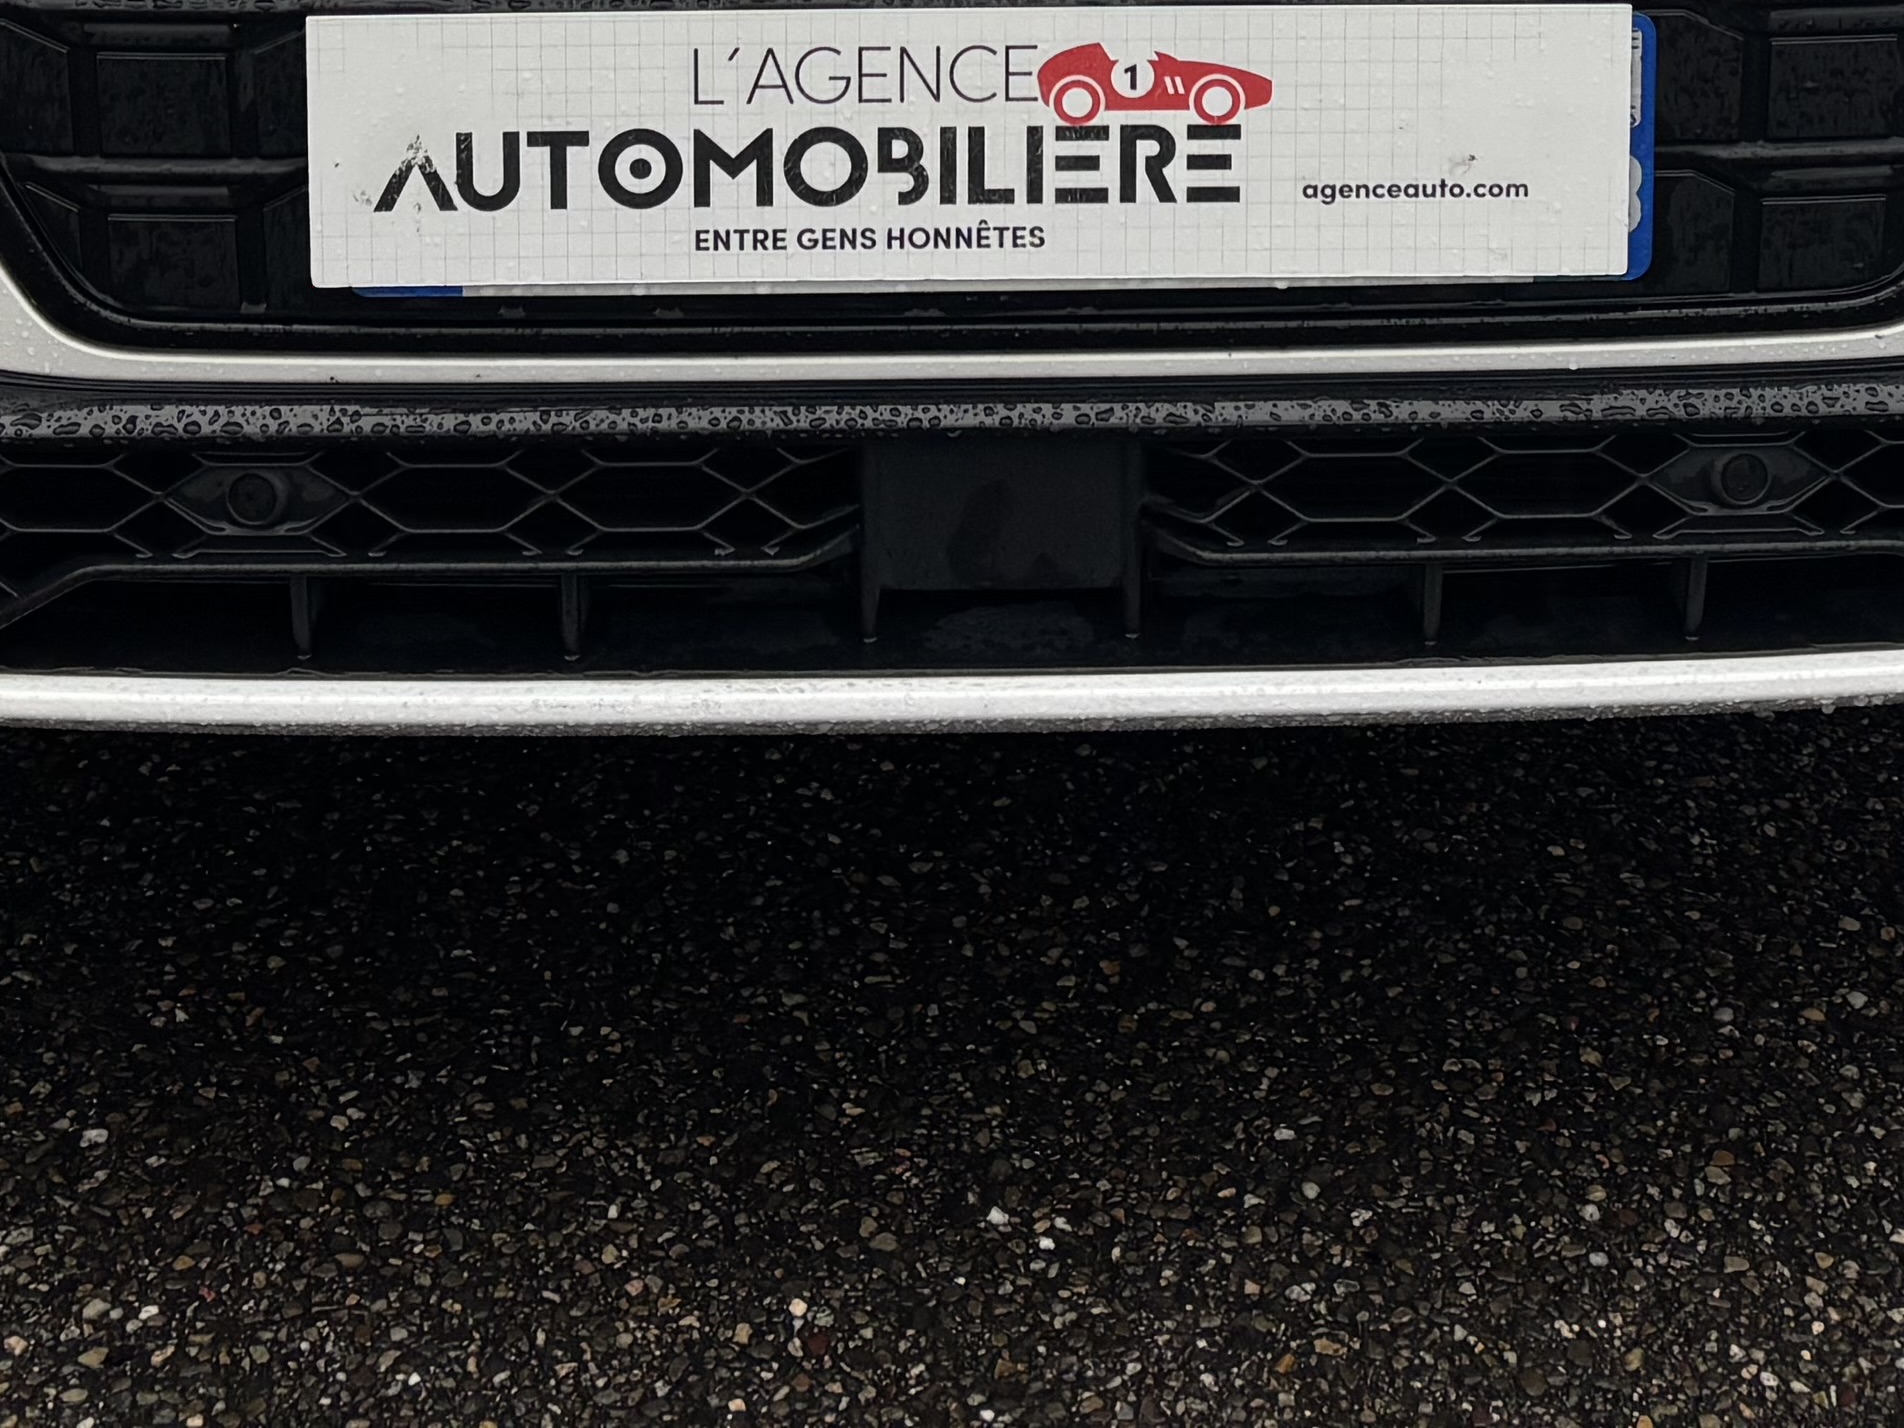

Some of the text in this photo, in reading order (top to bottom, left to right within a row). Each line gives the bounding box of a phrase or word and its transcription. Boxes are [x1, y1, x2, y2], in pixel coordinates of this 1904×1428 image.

[693, 44, 1039, 106] L'AGENCE
[1302, 178, 1529, 204] agenceauto.com
[695, 219, 1046, 252] ENTRE GENS HONNÊTES
